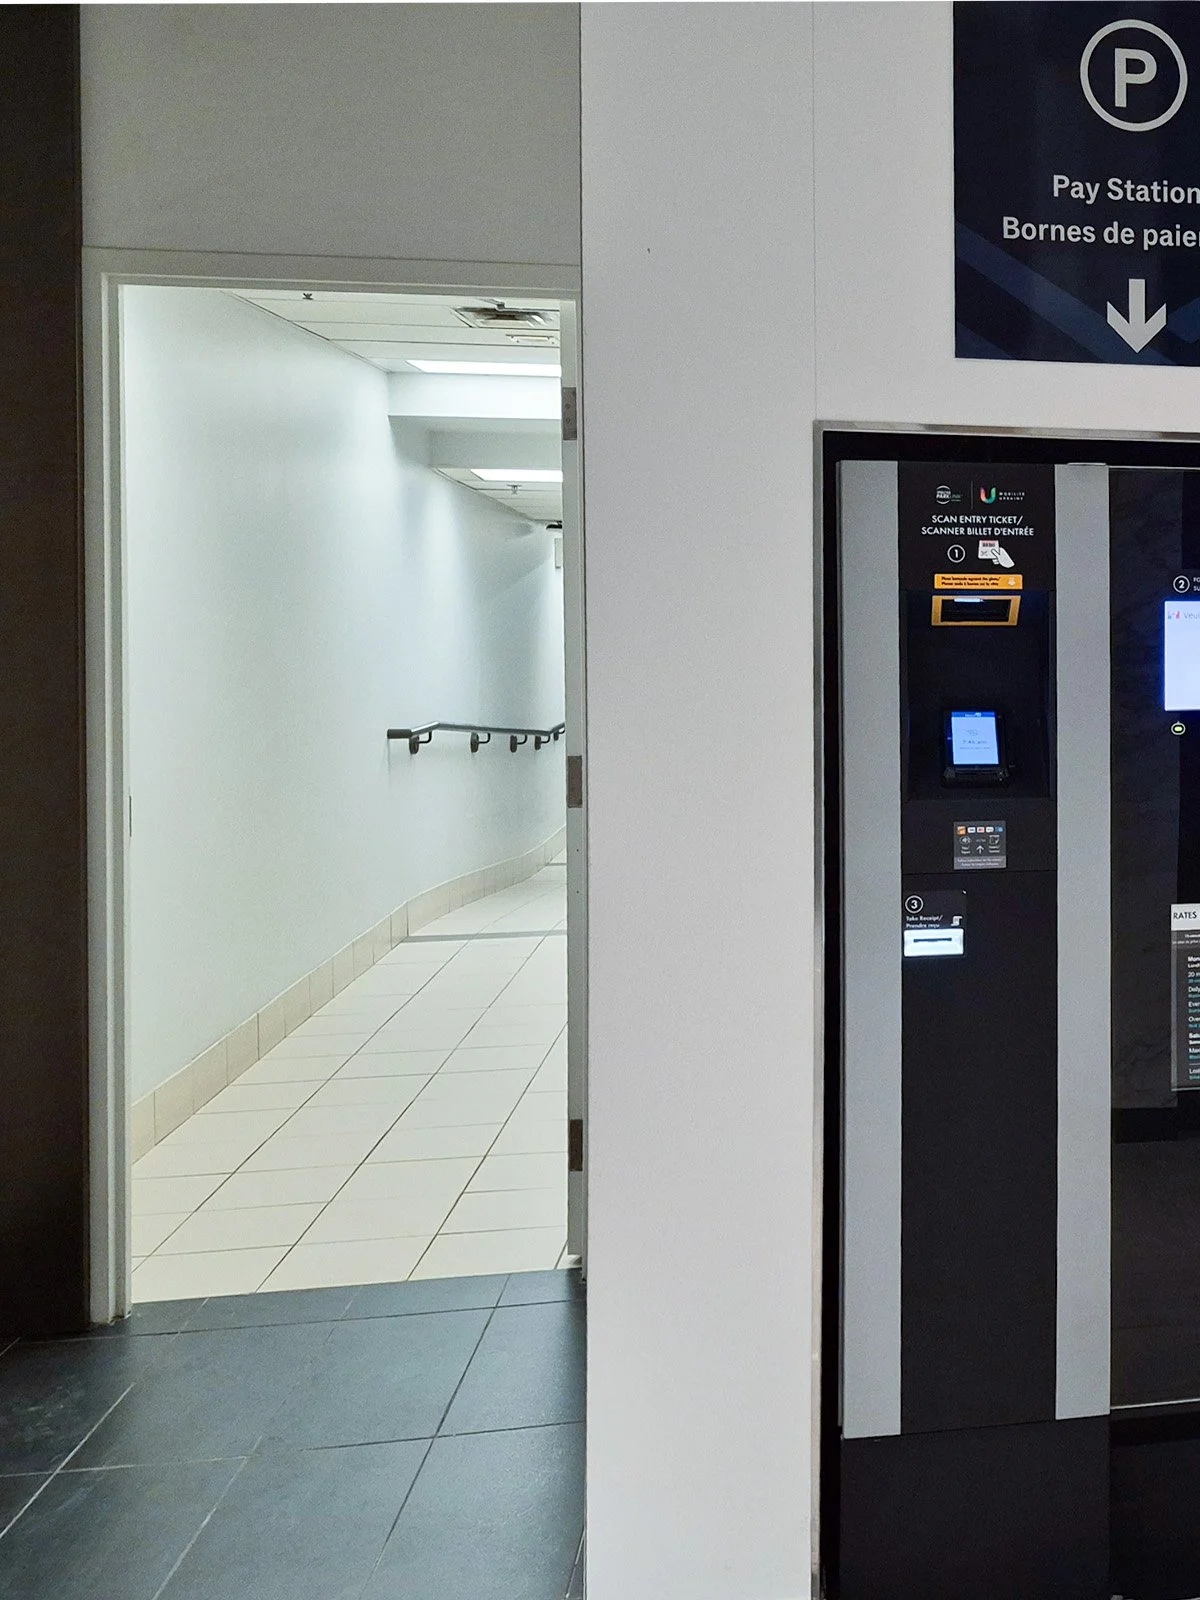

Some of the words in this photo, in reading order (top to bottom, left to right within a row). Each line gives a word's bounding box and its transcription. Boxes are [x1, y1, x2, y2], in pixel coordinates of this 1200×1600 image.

[1114, 47, 1158, 108] P
[1053, 174, 1100, 205] Pay
[1002, 216, 1096, 243] Bornes
[1103, 221, 1135, 245] de
[921, 526, 965, 535] SCANNER
[967, 527, 992, 535] BILLET
[994, 525, 1035, 536] D'ENTRÉE
[931, 515, 957, 524] SCAN
[959, 515, 987, 524] ENTRY
[989, 515, 1023, 526] TICKET/
[1173, 910, 1198, 919] RATES
